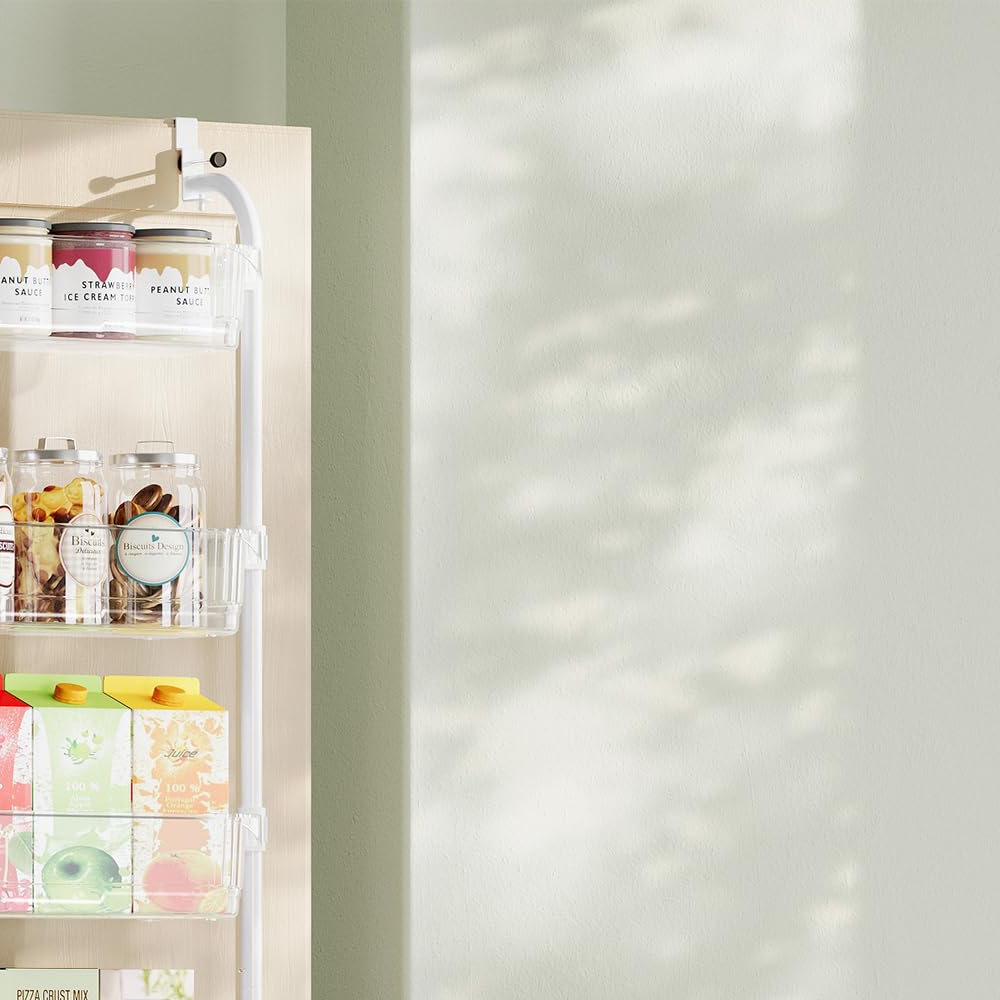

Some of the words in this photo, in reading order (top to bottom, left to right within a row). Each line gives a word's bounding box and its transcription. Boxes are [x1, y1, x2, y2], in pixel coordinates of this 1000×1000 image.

[14, 288, 42, 296] SAUCE
[150, 286, 190, 294] PEANUT
[64, 293, 79, 301] ICE
[83, 292, 117, 301] CREAM
[176, 297, 203, 306] SAUCE
[123, 542, 155, 550] Biscuits
[157, 542, 184, 552] Design
[163, 748, 198, 758] Juice
[165, 784, 186, 793] 100
